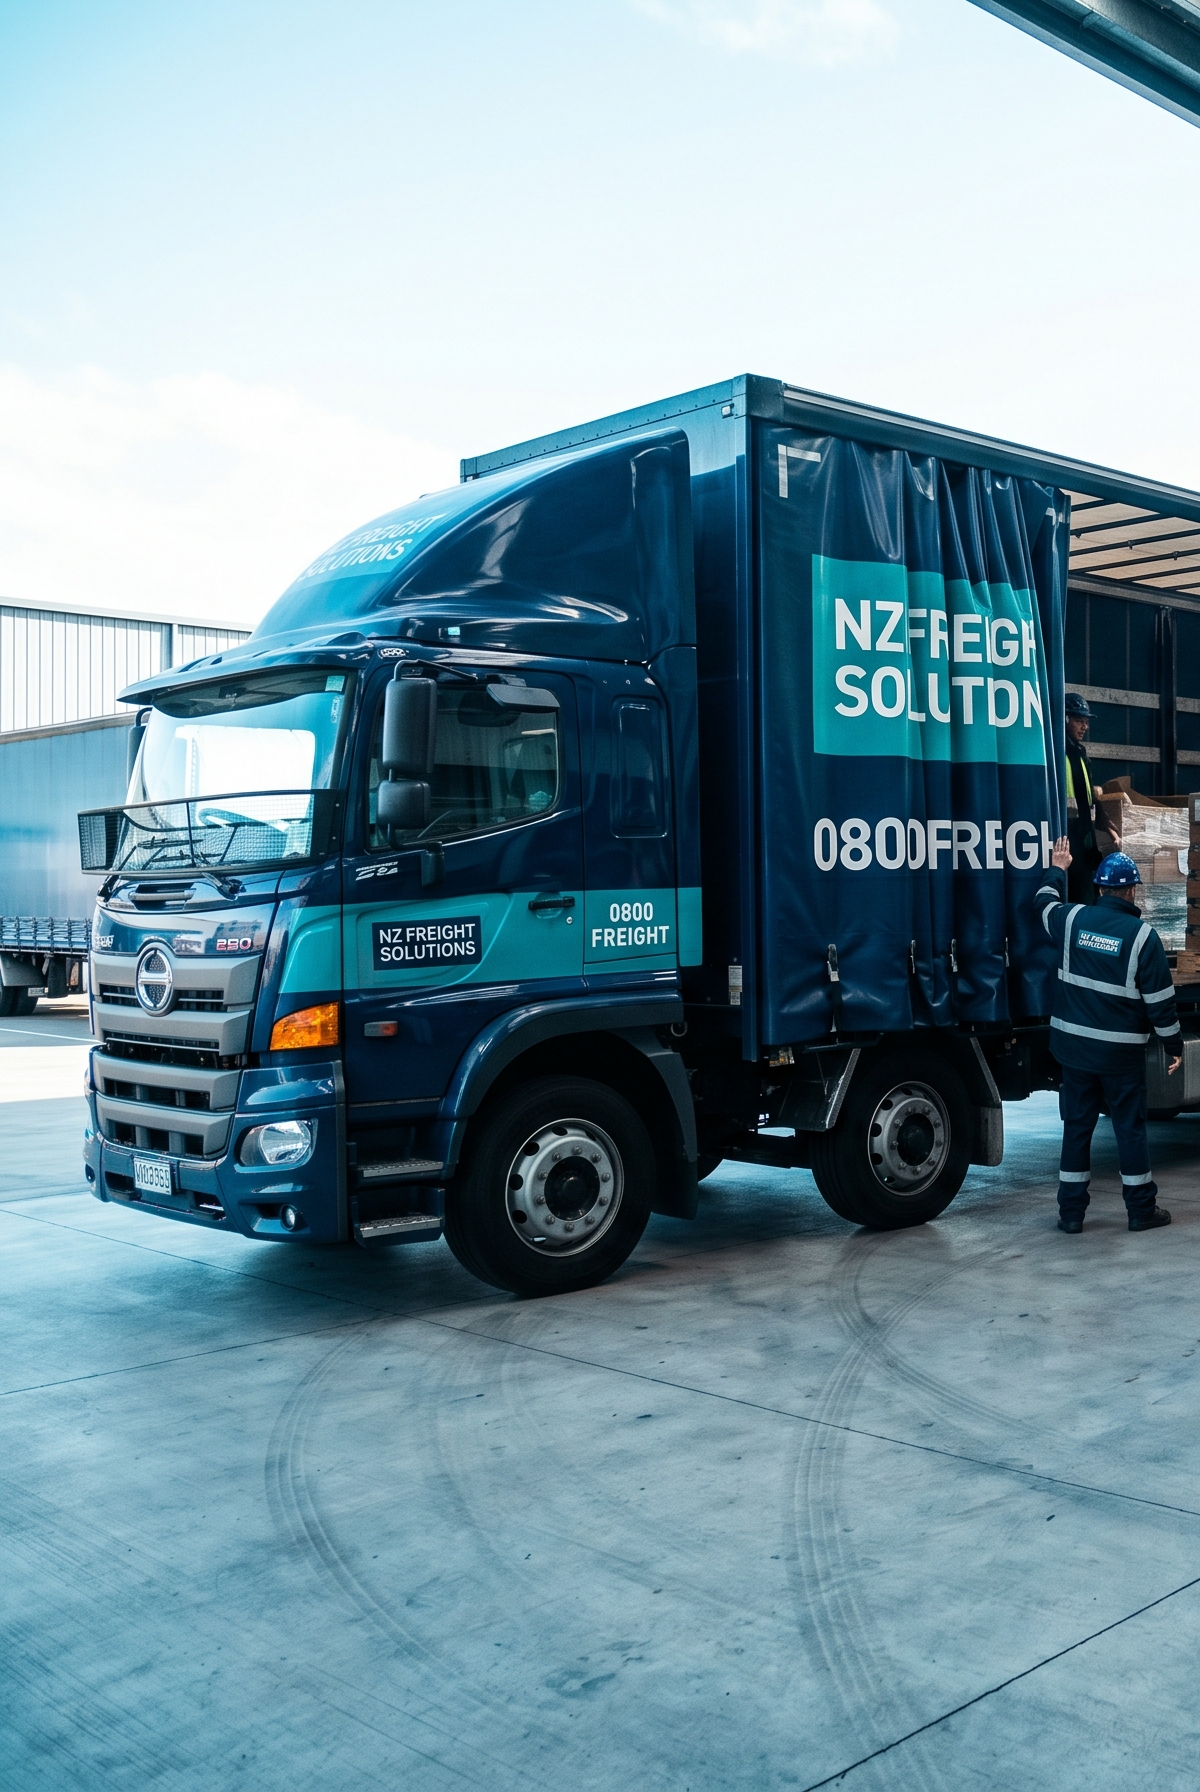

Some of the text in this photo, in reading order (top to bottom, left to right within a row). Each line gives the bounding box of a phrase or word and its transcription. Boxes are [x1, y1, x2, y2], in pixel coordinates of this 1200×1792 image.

[609, 901, 654, 923] 0800
[379, 923, 476, 945] NZ FREIGHT
[591, 925, 670, 948] FREIGHT
[379, 941, 476, 962] SOLUTIONS
